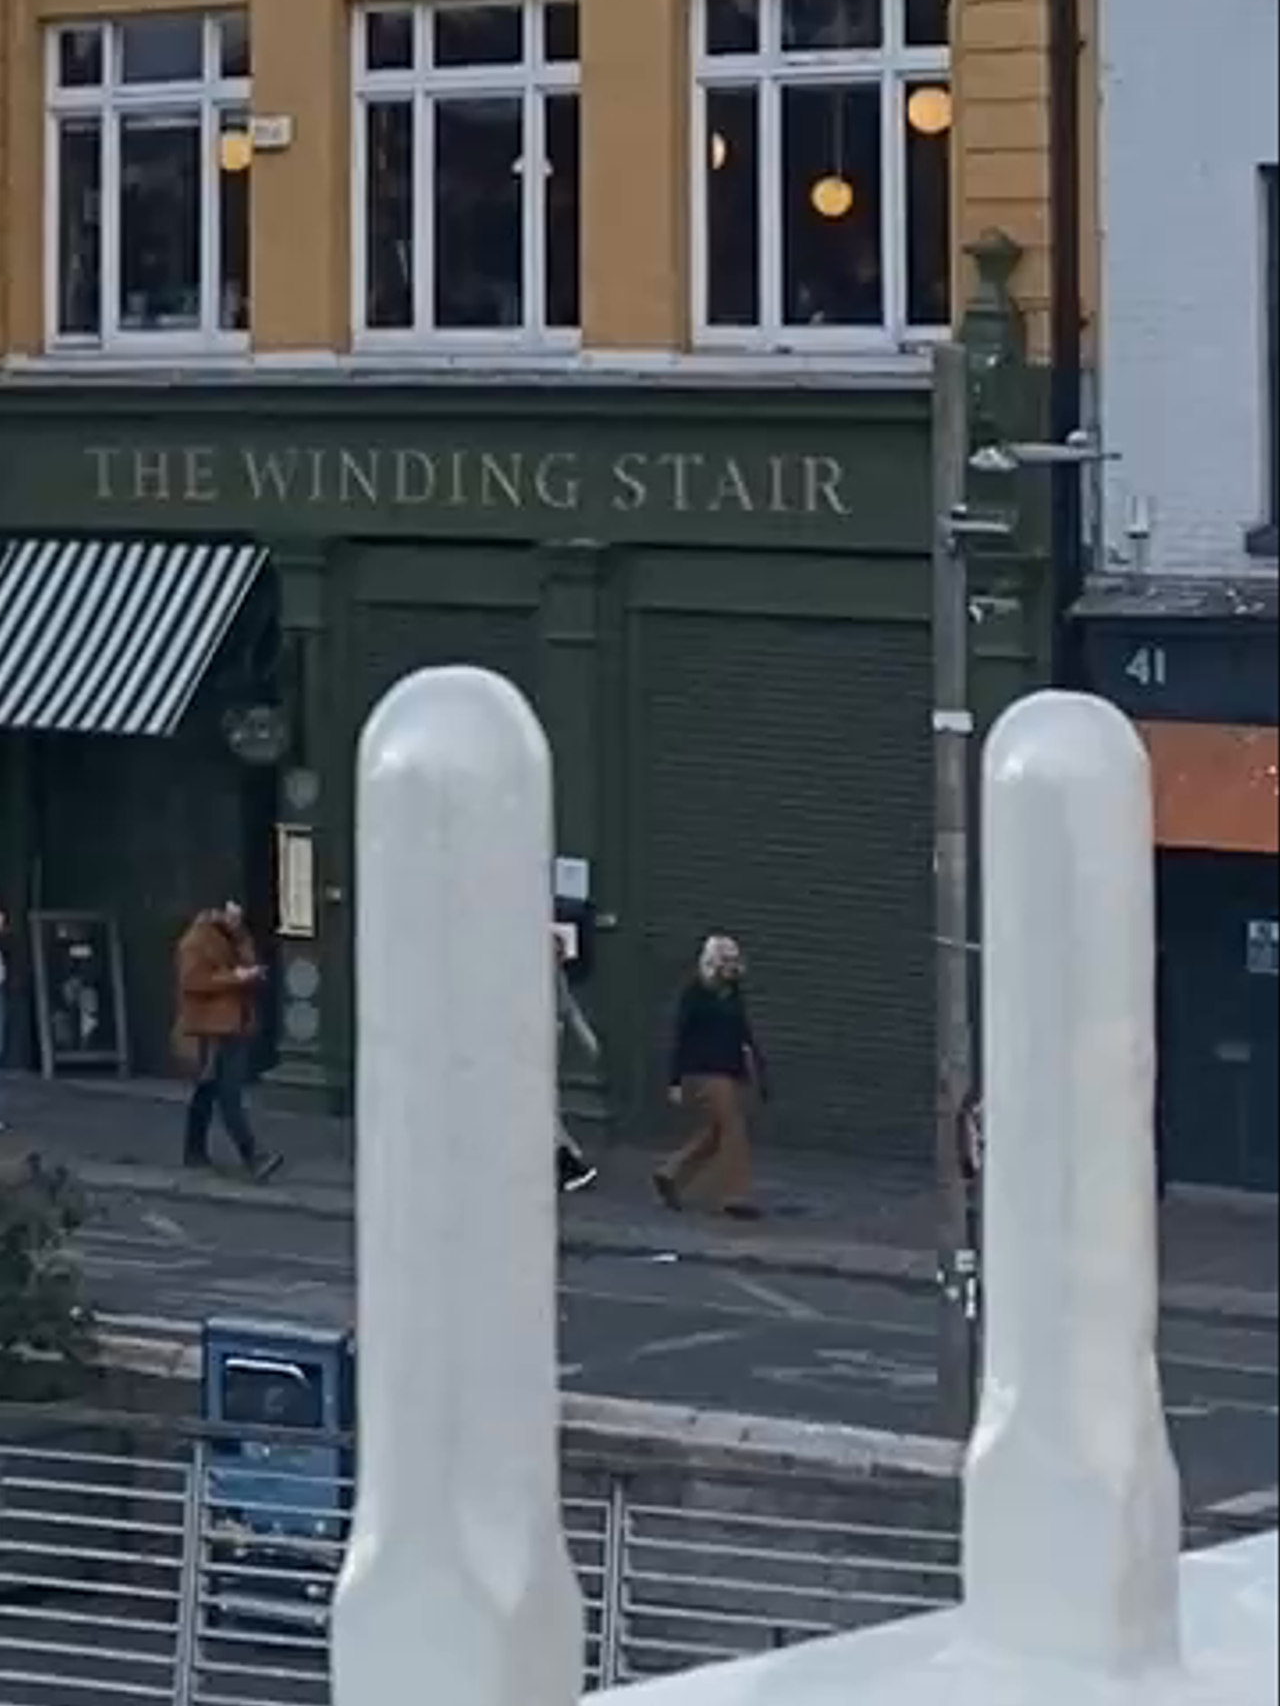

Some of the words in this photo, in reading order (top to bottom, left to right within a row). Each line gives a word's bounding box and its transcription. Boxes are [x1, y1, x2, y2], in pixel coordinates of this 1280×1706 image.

[83, 446, 219, 501] THE
[244, 447, 581, 509] WINDING
[611, 453, 853, 515] STAIR
[1125, 648, 1167, 685] 41
